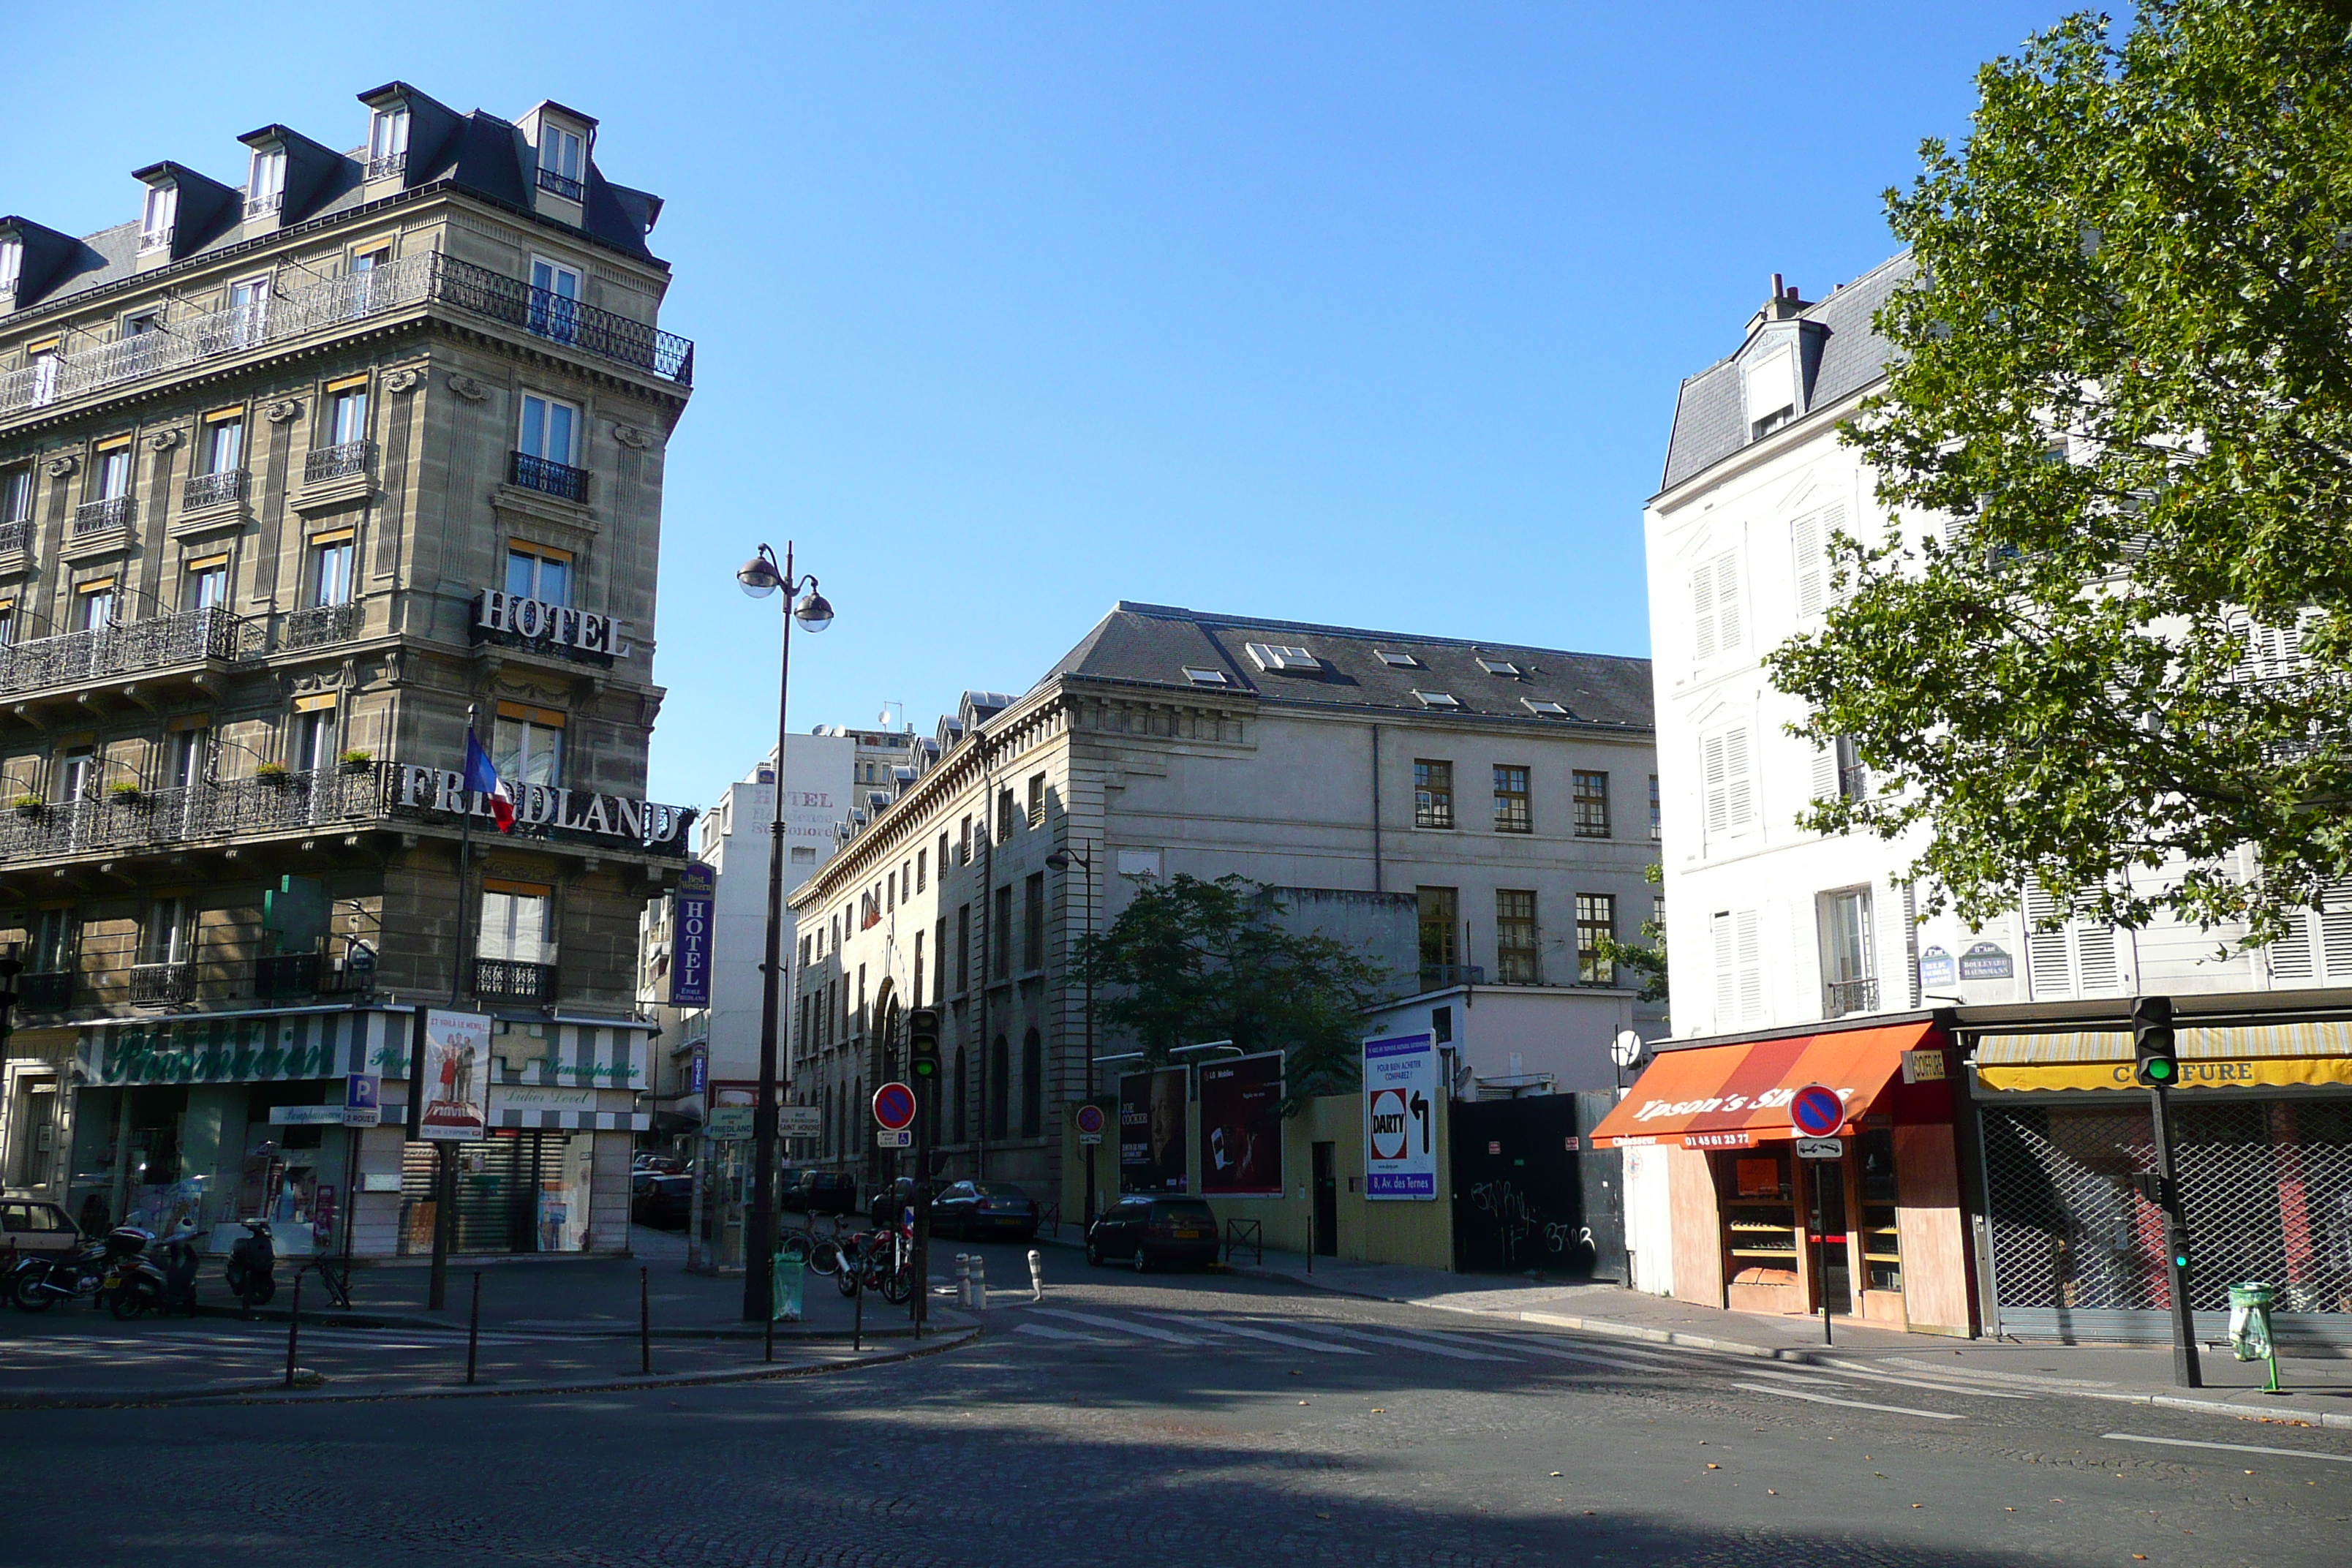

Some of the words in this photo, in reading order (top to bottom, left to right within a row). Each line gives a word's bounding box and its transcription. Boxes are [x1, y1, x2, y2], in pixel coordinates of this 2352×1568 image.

[476, 587, 629, 657] HOTEL
[688, 874, 704, 883] Best
[681, 881, 711, 892] Western
[685, 902, 704, 985] HOTEL
[1964, 959, 2008, 968] BOULEVARD
[1964, 967, 2008, 976] HAUSSMANN
[1376, 1063, 1389, 1073] POUR
[1390, 1062, 1401, 1071] BIEN
[1401, 1060, 1421, 1070] ACHETER
[1913, 1055, 1943, 1077] COIFFURE
[1210, 1070, 1216, 1079] LG
[1385, 1071, 1409, 1081] COMPAREZ
[356, 1080, 371, 1102] P
[1122, 1102, 1134, 1114] JOE
[1632, 1093, 1749, 1122] Ypson's
[1747, 1088, 1855, 1109] Shs
[1122, 1113, 1147, 1125] COCKER
[1373, 1113, 1404, 1134] DARTY
[710, 1125, 753, 1133] FRIEDLAND
[1613, 1134, 1656, 1147] Chausseur
[1685, 1136, 1697, 1146] 01
[1698, 1136, 1710, 1145] 45
[1711, 1135, 1722, 1145] 61
[1724, 1135, 1735, 1145] 23
[1738, 1134, 1749, 1144] 77
[1382, 1177, 1392, 1188] Av.
[1394, 1175, 1406, 1188] des
[1406, 1176, 1428, 1188] Ternes
